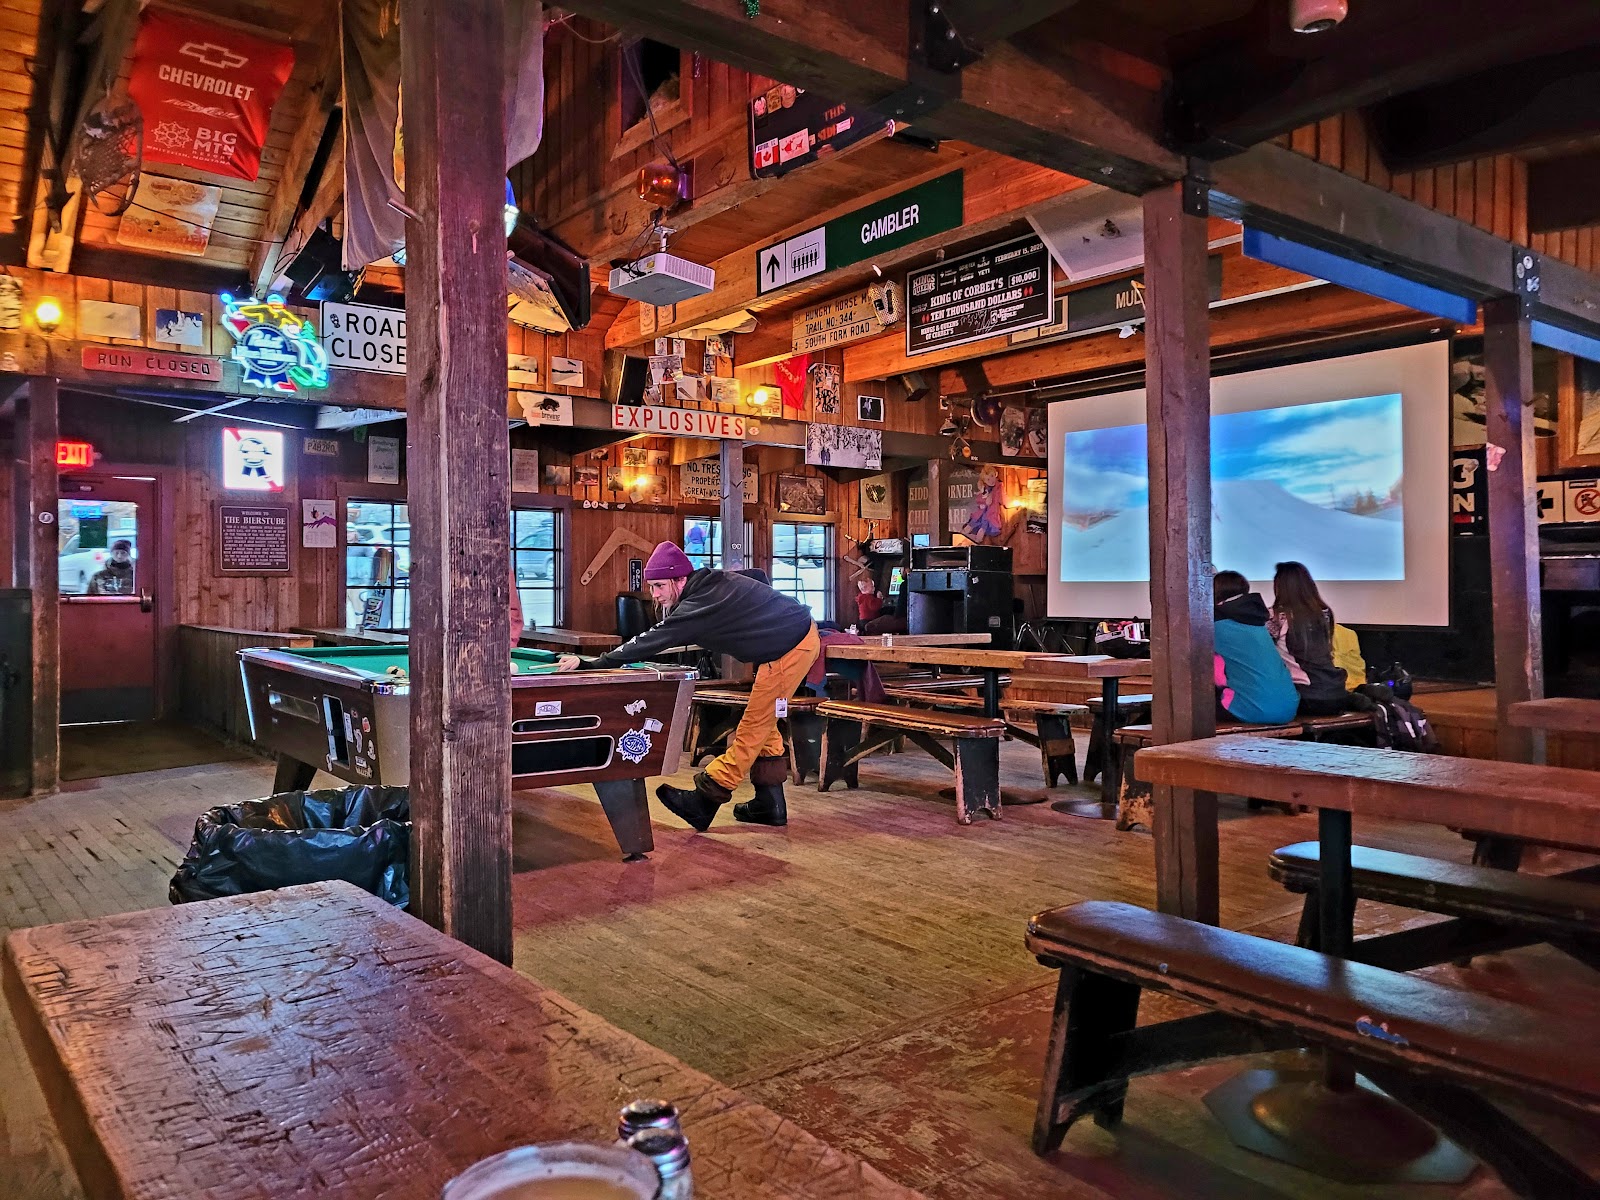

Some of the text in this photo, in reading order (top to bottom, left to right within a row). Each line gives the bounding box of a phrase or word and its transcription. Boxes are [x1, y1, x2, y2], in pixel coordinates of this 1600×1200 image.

[159, 65, 254, 100] CHEVROLET
[824, 102, 846, 120] THIS
[196, 127, 238, 144] BIG
[817, 124, 836, 141] SID
[192, 150, 231, 160] RESORT
[193, 139, 235, 155] MTN
[193, 155, 230, 165] MONTANA
[861, 204, 919, 244] GAMBLER
[995, 249, 1021, 262] FEBRUARY
[1030, 243, 1044, 252] 2020
[913, 273, 935, 289] KINGS
[978, 268, 990, 276] YETI
[930, 292, 951, 307] KING
[952, 289, 963, 301] OF
[964, 277, 1004, 297] CORBET'S
[1011, 271, 1037, 285] $10,000
[1116, 289, 1143, 309] MUL
[805, 305, 832, 321] HUNGRY
[835, 296, 858, 312] HORSE
[930, 309, 945, 321] TEN
[946, 298, 986, 317] THOUSAND
[987, 288, 1022, 305] DOLLARS
[346, 313, 406, 339] ROAD
[805, 321, 823, 334] TRAIL
[840, 311, 853, 324] 344
[805, 322, 870, 348] SOUTH FORK ROAD
[331, 338, 406, 365] CLOSE
[98, 354, 210, 375] RUN CLOSED
[614, 405, 743, 436] EXPLOSIVES
[57, 443, 88, 464] EXIT
[691, 476, 720, 486] PROPERT
[909, 484, 973, 501] KIDD RNER
[224, 516, 286, 525] THE BIERSTUBE
